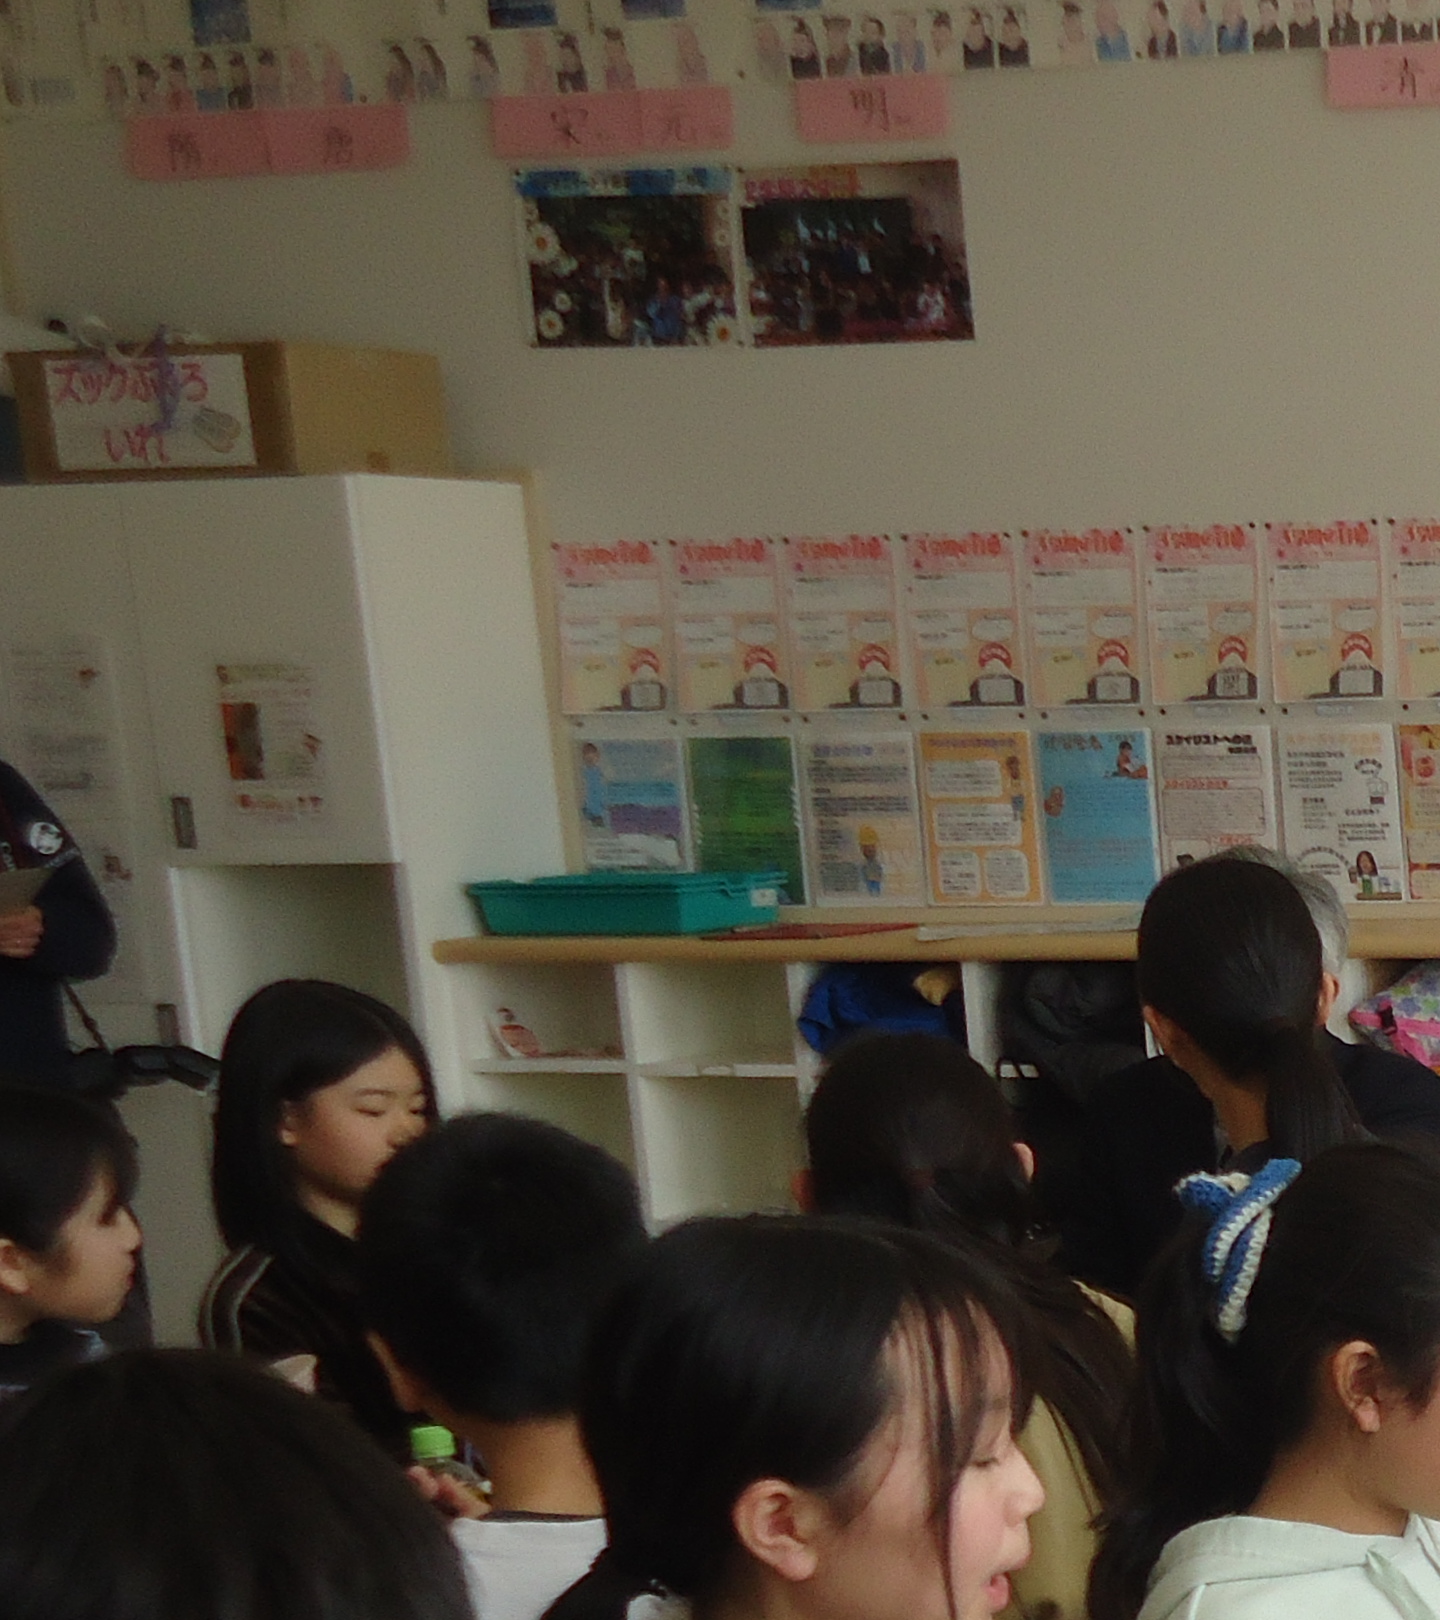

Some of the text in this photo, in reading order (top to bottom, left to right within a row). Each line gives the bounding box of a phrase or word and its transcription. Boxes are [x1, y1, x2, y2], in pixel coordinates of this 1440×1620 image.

[850, 88, 893, 131] 明
[53, 361, 208, 404] ズックぶろ
